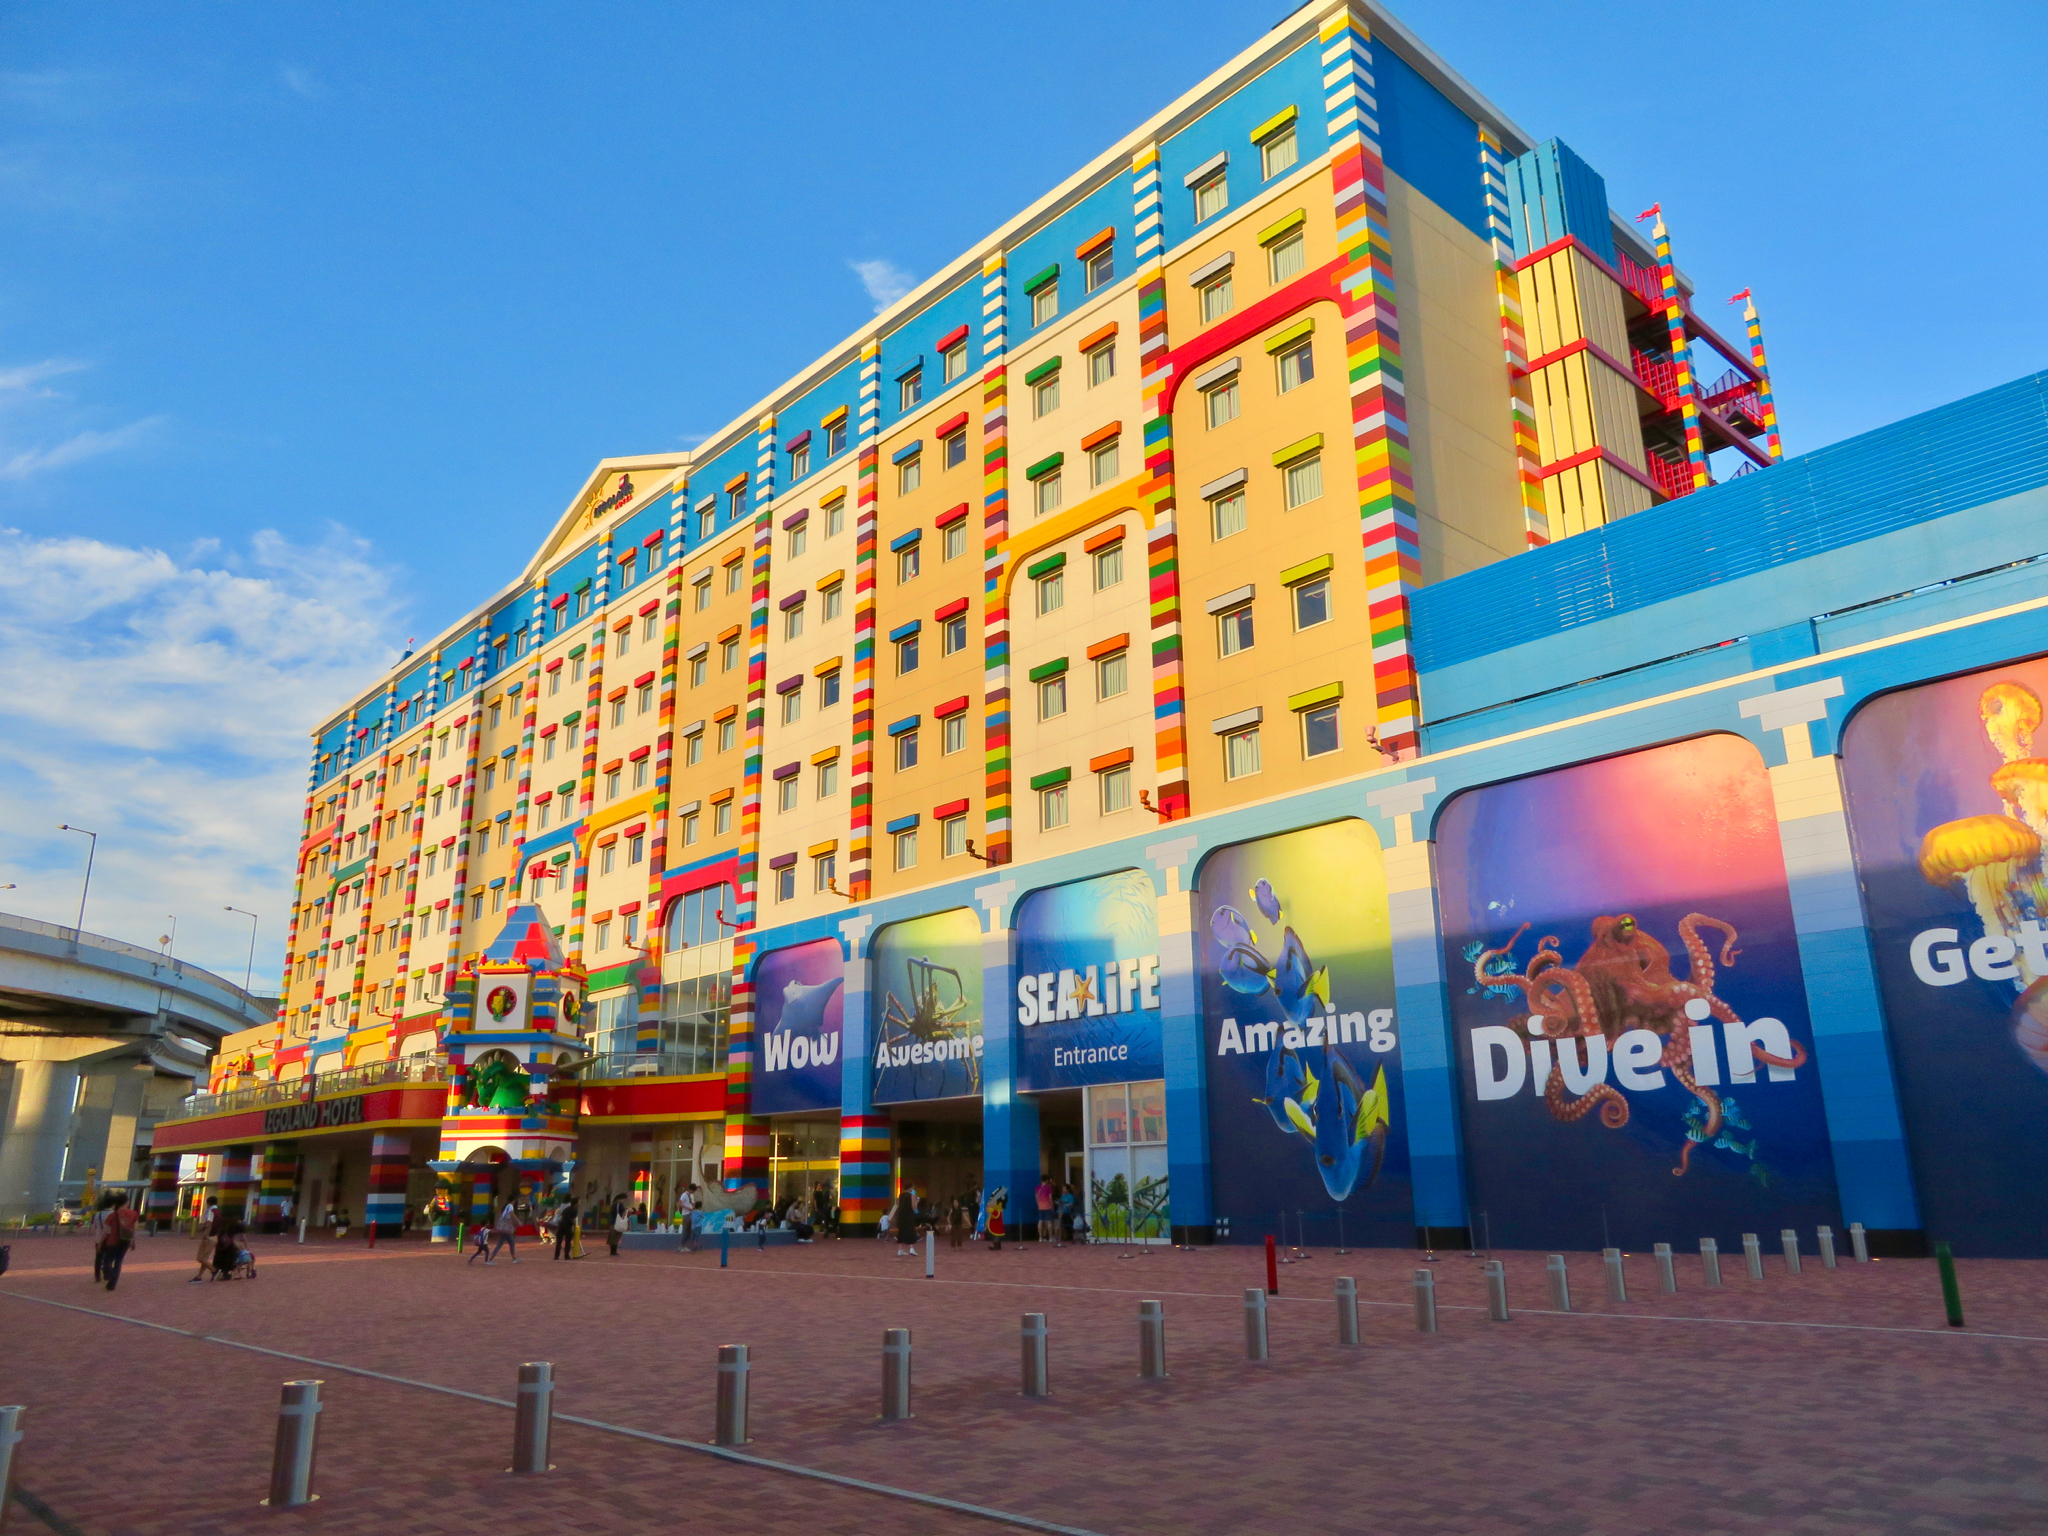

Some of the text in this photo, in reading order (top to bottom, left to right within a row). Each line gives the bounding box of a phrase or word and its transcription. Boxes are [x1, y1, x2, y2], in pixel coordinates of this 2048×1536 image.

[1909, 919, 2048, 987] Get
[764, 1028, 838, 1072] Wow
[1217, 1002, 1396, 1056] Amazing
[1470, 997, 1796, 1101] Dive in
[876, 1034, 984, 1069] Awesome
[1054, 1044, 1128, 1066] Entrance
[264, 1095, 362, 1132] LEGOLAND HOTEL
